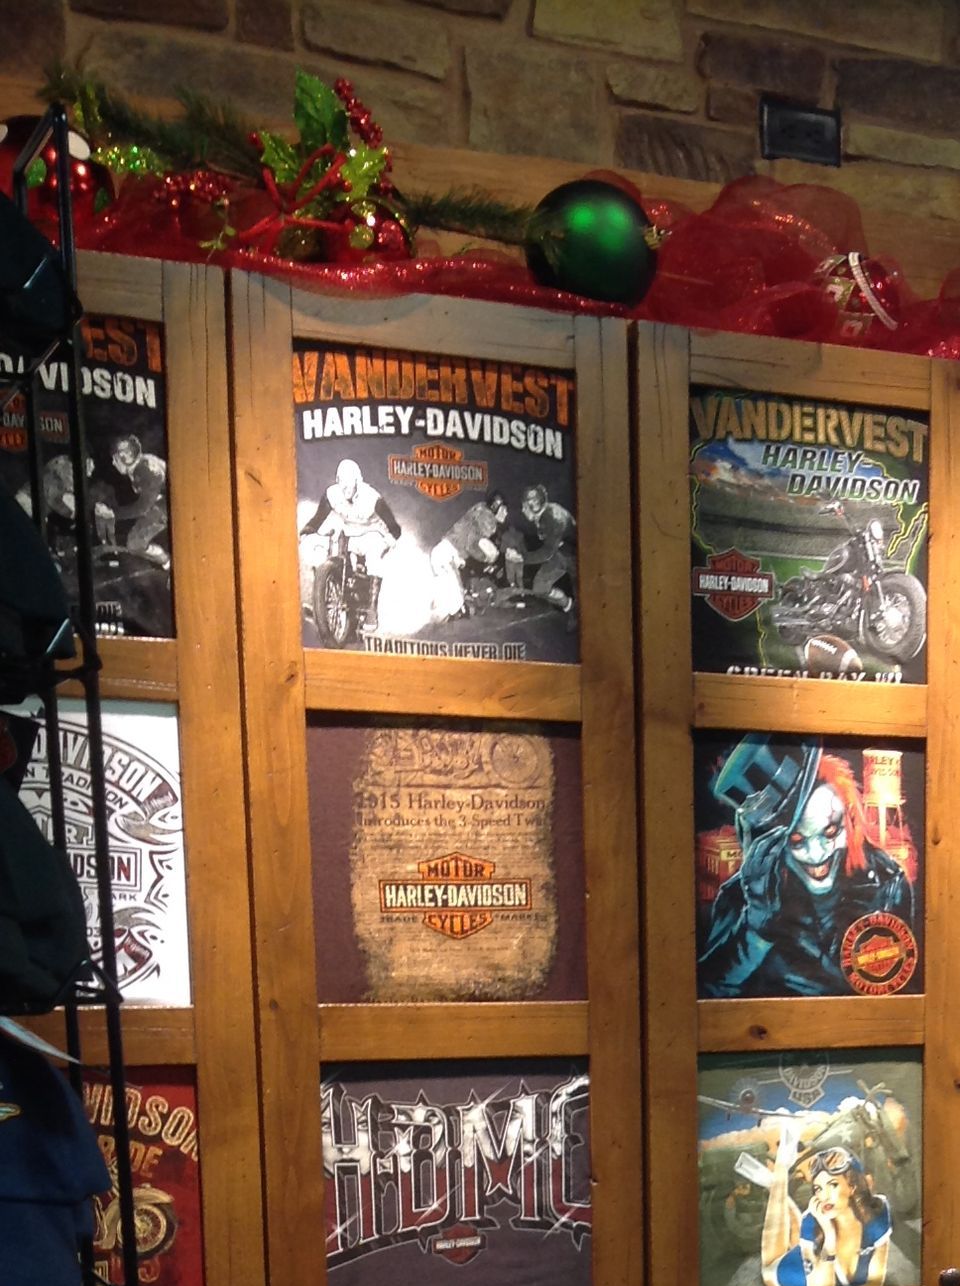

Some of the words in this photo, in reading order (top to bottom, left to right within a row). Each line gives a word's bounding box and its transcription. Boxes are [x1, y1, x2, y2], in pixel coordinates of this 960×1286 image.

[291, 350, 574, 427] VANDERVEST
[302, 405, 564, 460] HARLEY-DAVIDSON
[689, 397, 928, 464] VANDERVEST
[393, 461, 483, 481] HARLEY-DAVIDSON
[787, 471, 921, 505] DAVIDSON
[699, 573, 769, 593] HARLEY-DAVIDSON
[365, 637, 448, 657] TRADITIONS
[408, 792, 546, 813] Harley-Davidson
[427, 863, 485, 878] MOTOR
[384, 884, 528, 907] HARLEY-DAVIDSON
[427, 913, 488, 935] CYCLES
